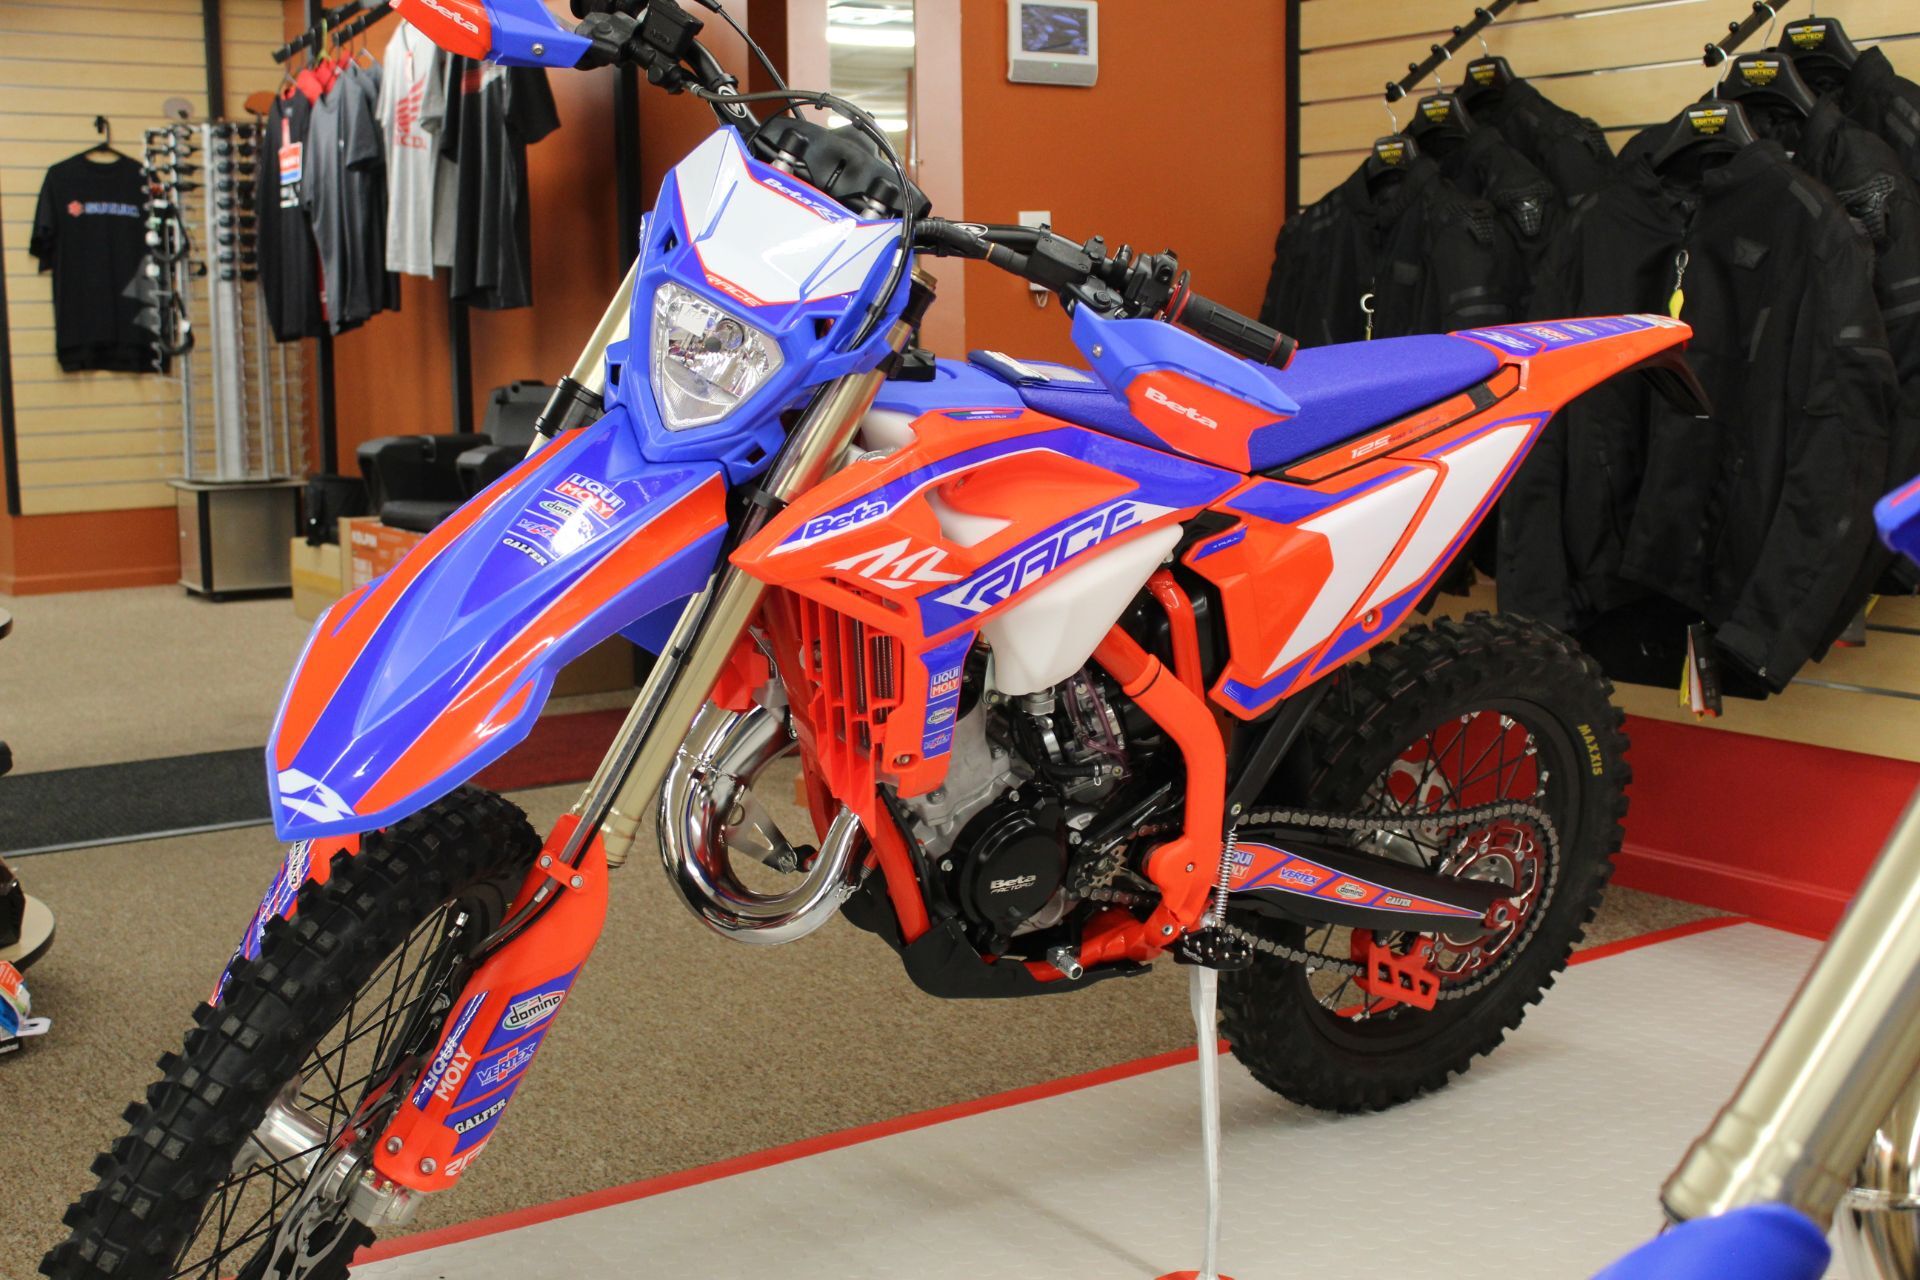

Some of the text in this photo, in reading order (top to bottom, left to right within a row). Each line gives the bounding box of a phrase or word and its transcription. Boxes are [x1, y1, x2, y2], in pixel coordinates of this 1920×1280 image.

[763, 178, 813, 206] Beta
[1144, 387, 1218, 430] Beta
[559, 483, 615, 516] MOLY
[569, 474, 622, 508] LIQUI
[803, 502, 888, 541] Beta
[502, 538, 549, 566] GALFER
[960, 501, 1143, 605] RACE
[932, 678, 959, 696] MOLY
[933, 668, 959, 686] LIQUI
[1577, 724, 1603, 776] MAXXIS
[1230, 851, 1253, 865] QUI
[991, 875, 1036, 889] Beta
[1280, 867, 1320, 886] VERTEX
[510, 995, 561, 1024] domino
[435, 1044, 472, 1102] MOLY
[477, 1042, 537, 1086] VERTEX
[454, 1098, 507, 1135] GALFER
